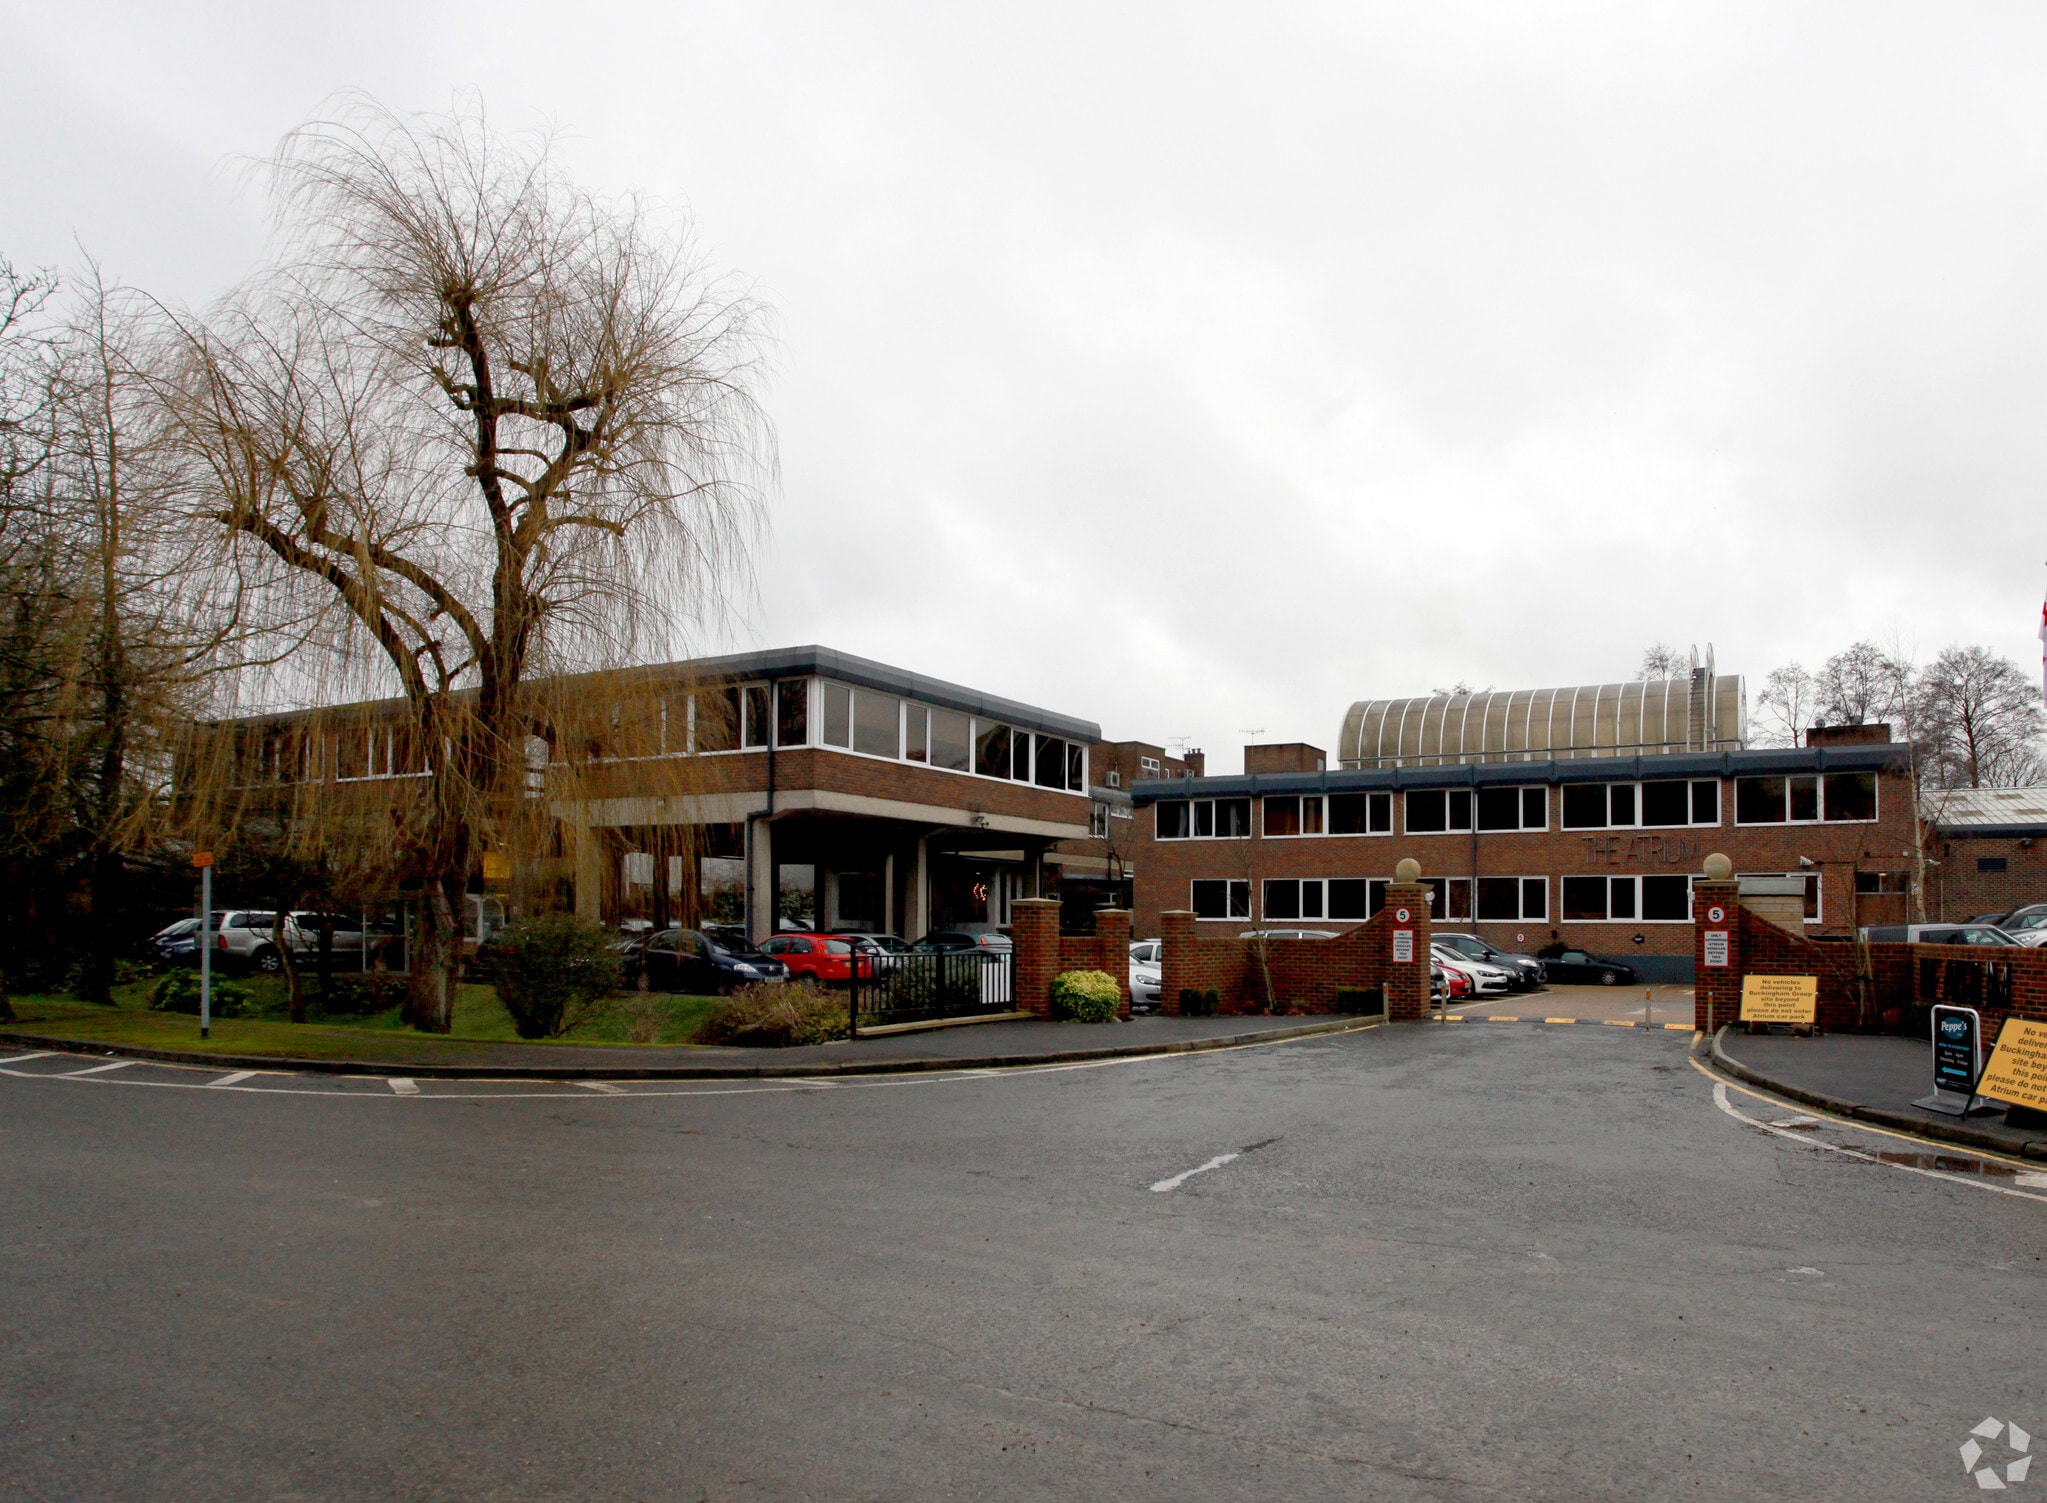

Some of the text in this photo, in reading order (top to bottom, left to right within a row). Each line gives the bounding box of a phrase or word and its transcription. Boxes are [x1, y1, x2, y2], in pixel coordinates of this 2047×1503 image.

[1581, 835, 1700, 865] THE ATRIUM
[1400, 911, 1406, 919] 5
[1713, 910, 1720, 919] 5
[1941, 1020, 1967, 1033] Peppe's
[2024, 1027, 2036, 1036] No
[2012, 1058, 2029, 1066] site
[2012, 1068, 2029, 1077] this
[1986, 1074, 2047, 1092] please do not
[1991, 1084, 2020, 1097] Atrium
[2022, 1092, 2037, 1101] car
